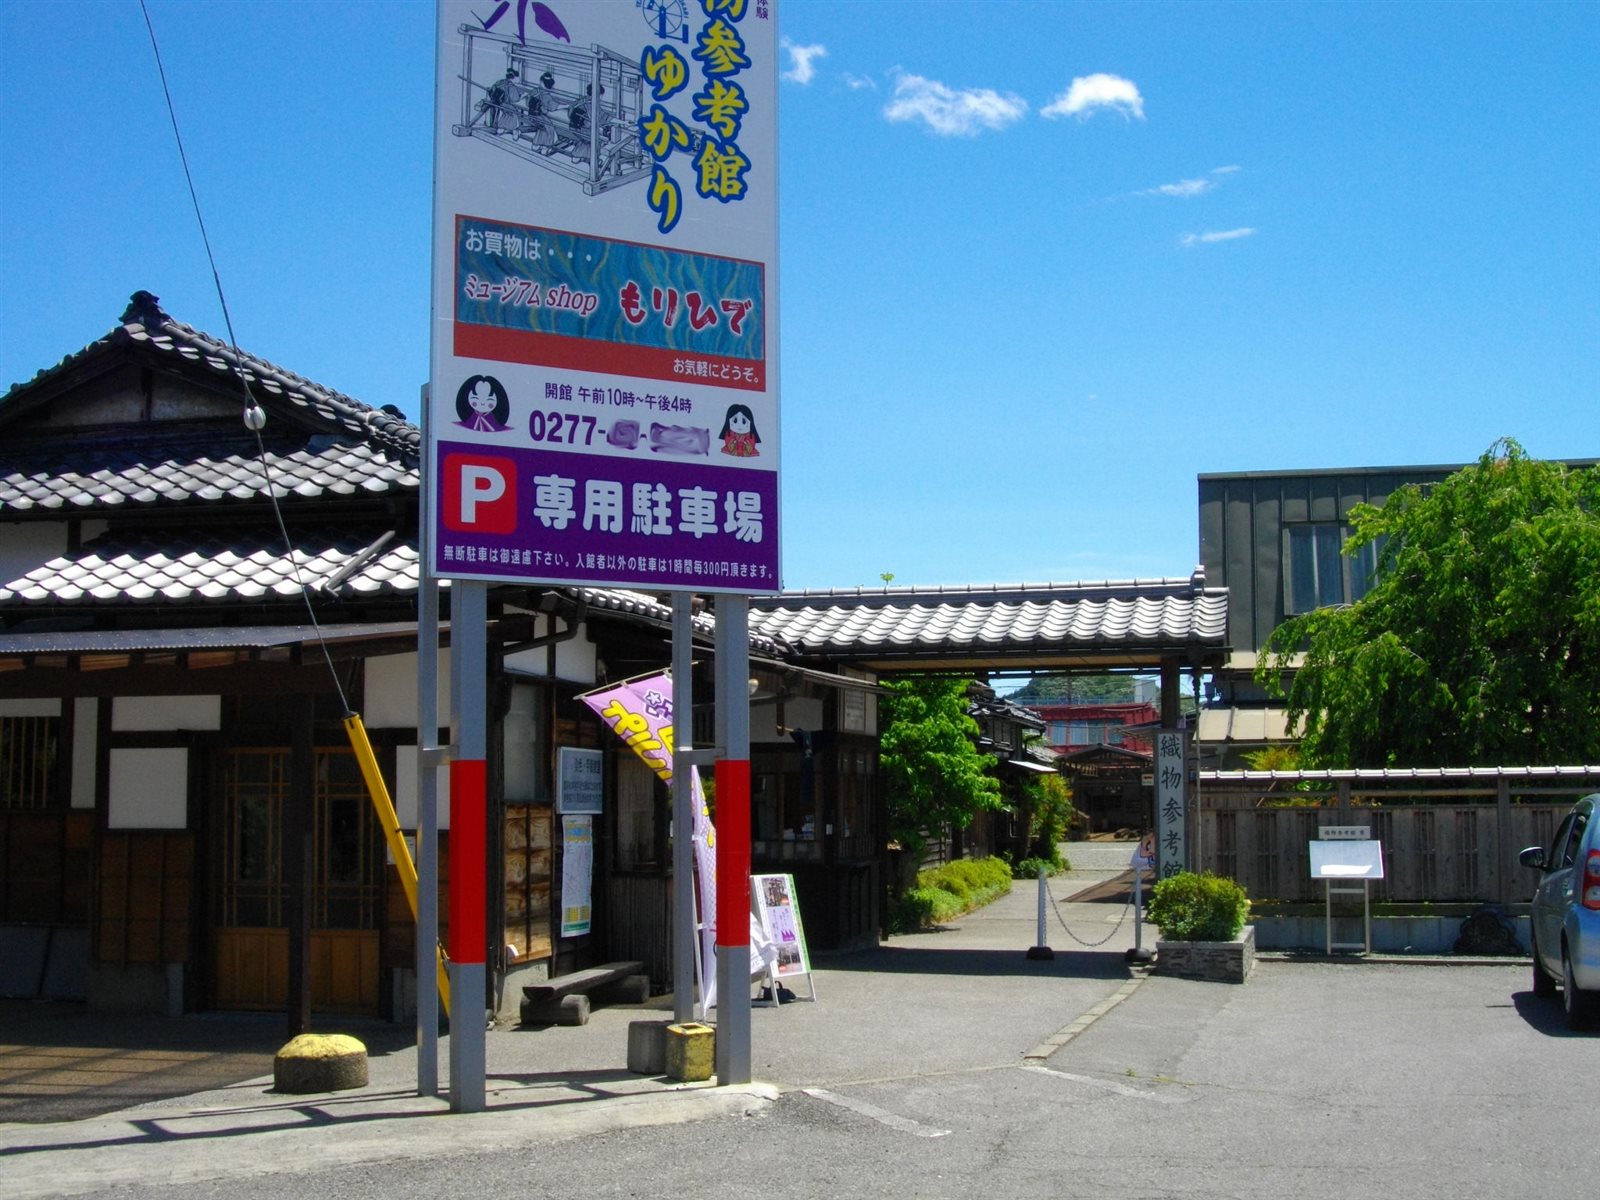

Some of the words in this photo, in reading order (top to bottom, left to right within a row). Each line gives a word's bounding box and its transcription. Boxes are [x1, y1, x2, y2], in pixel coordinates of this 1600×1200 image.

[637, 44, 694, 234] ゆかり
[464, 274, 541, 306] ミュージアム
[546, 283, 598, 317] shop
[619, 280, 753, 336] もりひで
[545, 382, 573, 401] 開館
[673, 358, 760, 385] お気軽にどうぞ。
[461, 464, 506, 524] P
[532, 473, 764, 543] 専用駐車場
[1159, 734, 1183, 878] 織物参考館
